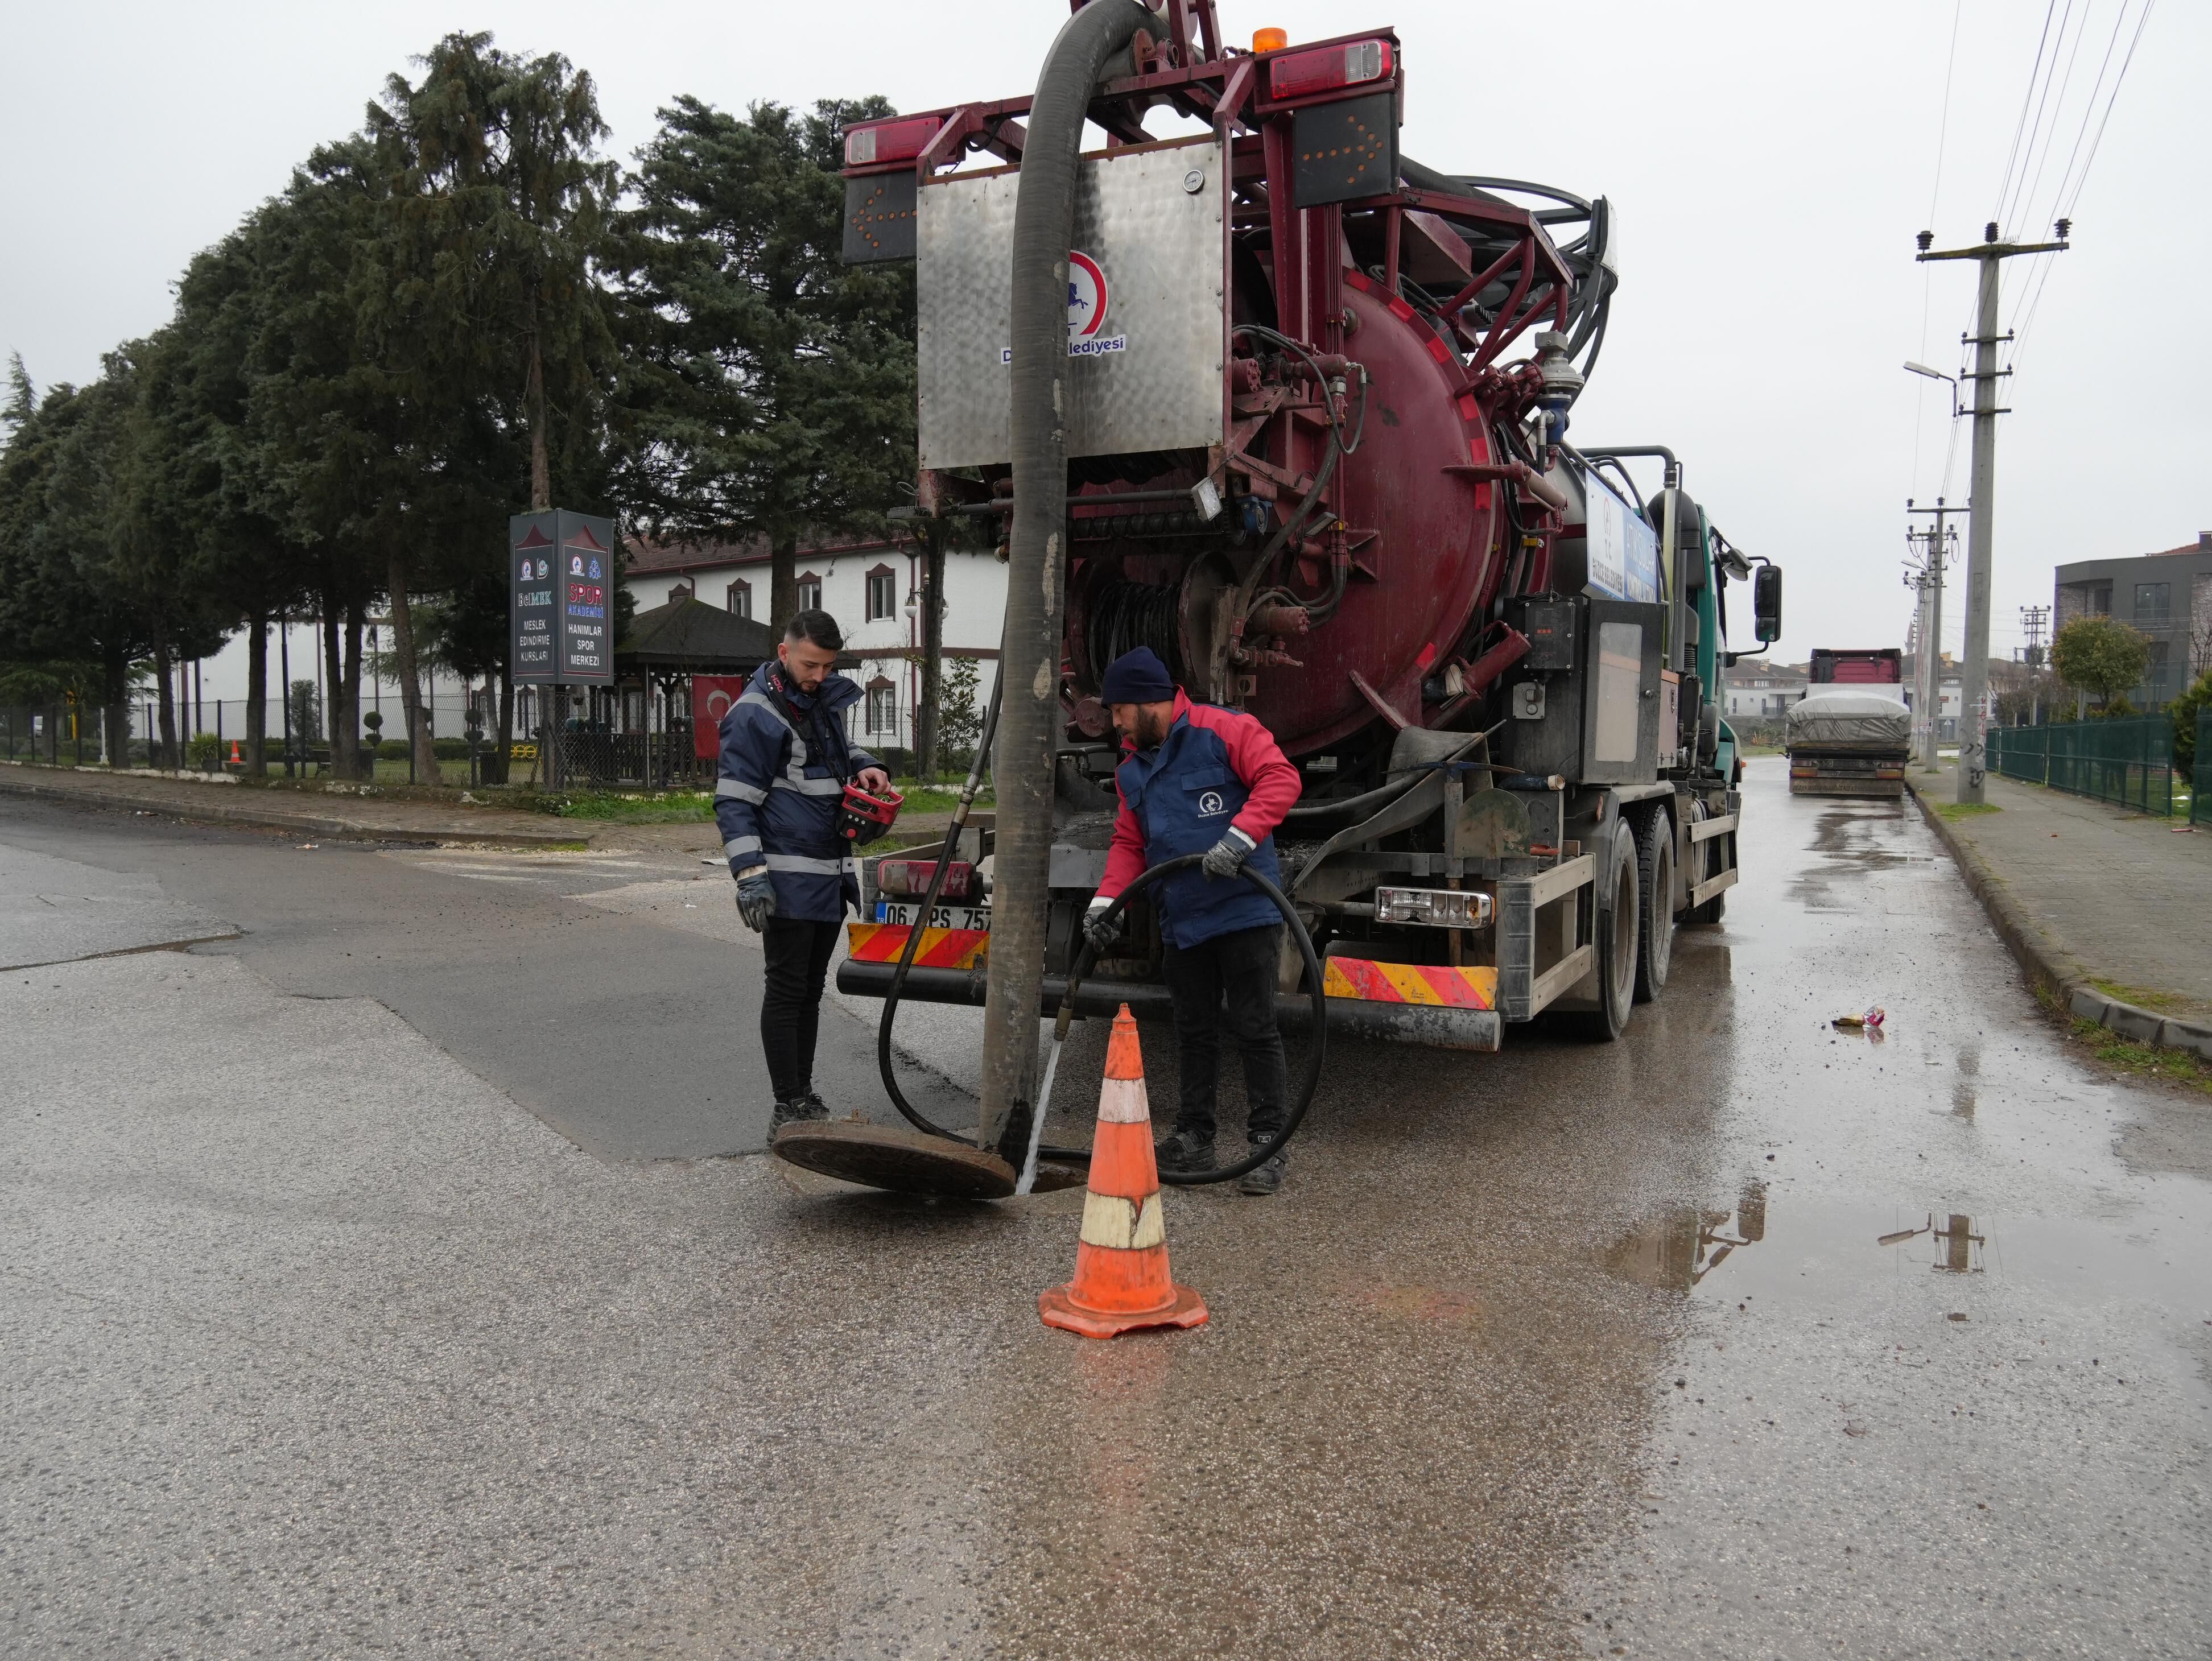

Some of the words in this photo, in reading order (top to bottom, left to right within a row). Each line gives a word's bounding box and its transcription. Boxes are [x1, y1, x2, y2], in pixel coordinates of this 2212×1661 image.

[1069, 338, 1123, 354] lediyesi
[518, 591, 551, 606] BelMEK
[568, 582, 602, 605] SPOR
[524, 619, 546, 630] MESLEK
[568, 623, 602, 637] HANIMLAR
[577, 639, 595, 651] SPOR
[521, 651, 548, 662] KURSLARI
[571, 654, 600, 666] MERKEZİ
[887, 905, 907, 925] 06
